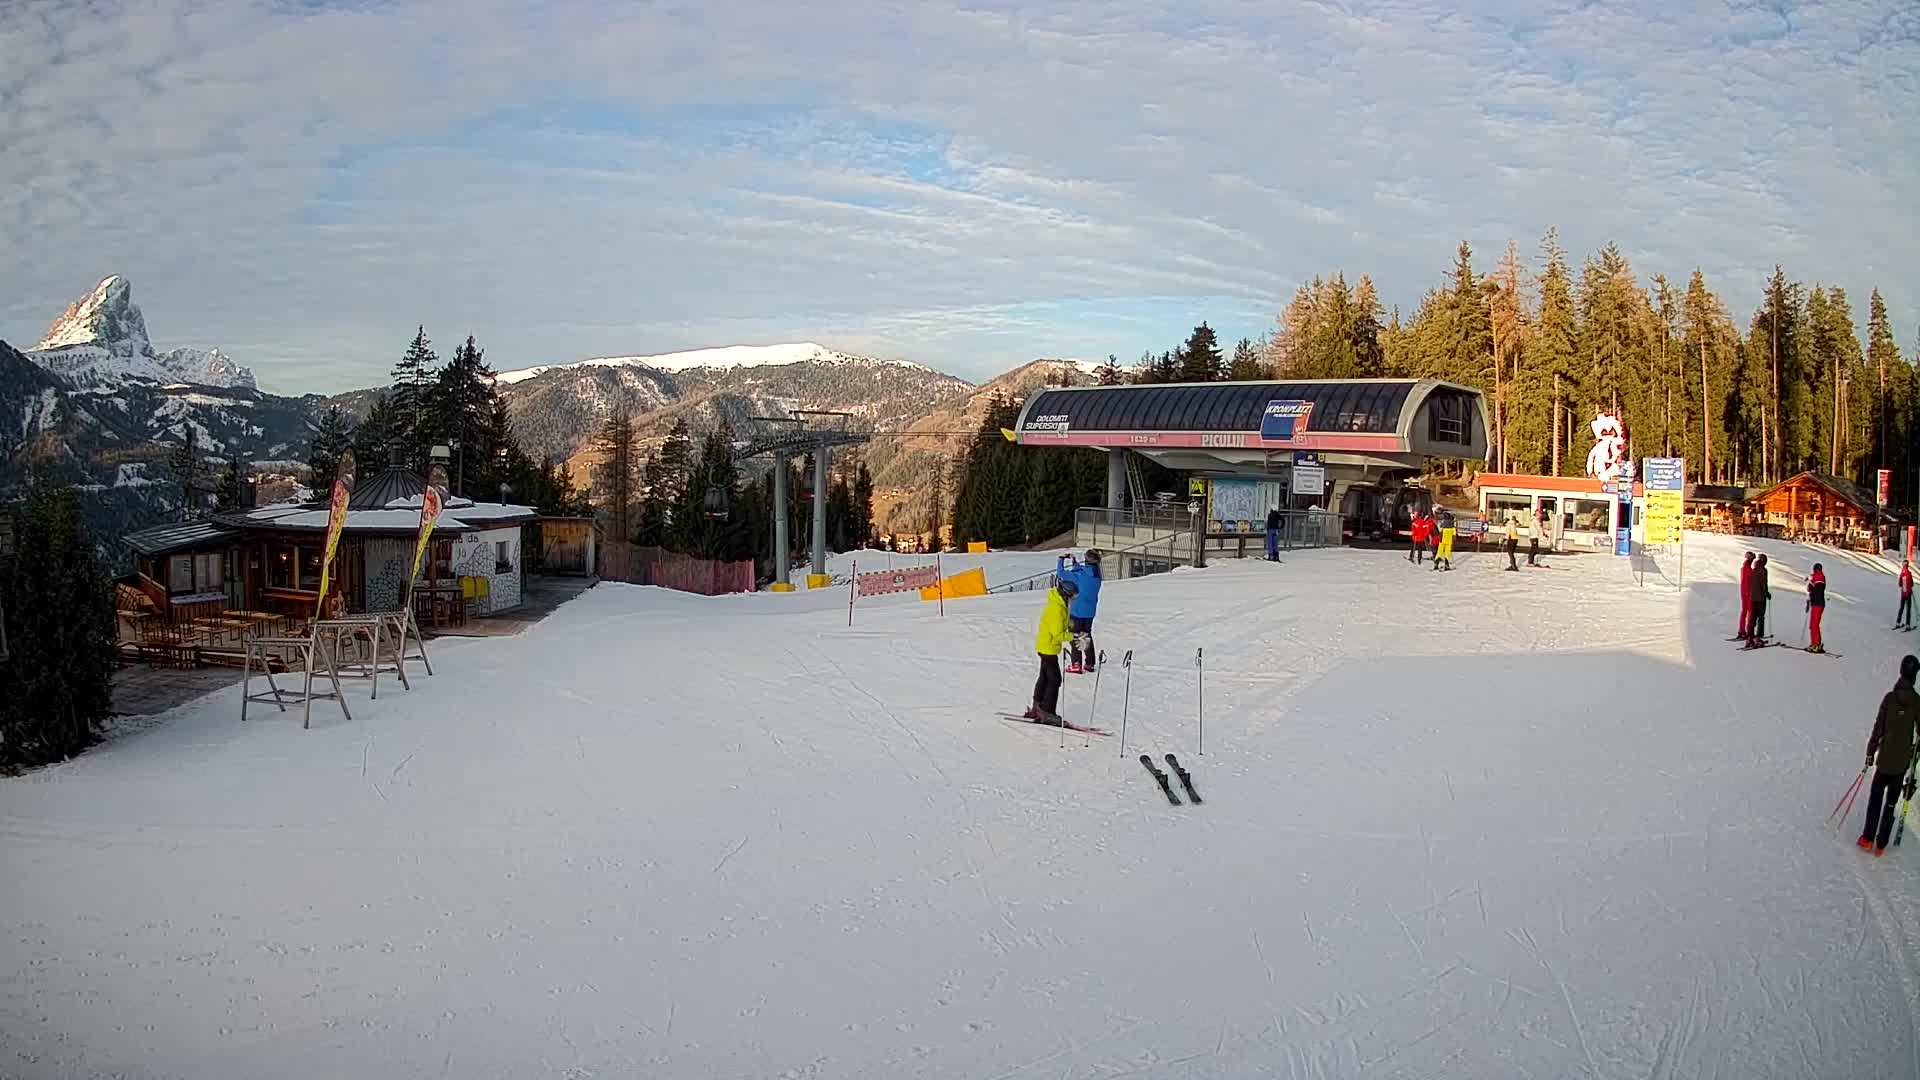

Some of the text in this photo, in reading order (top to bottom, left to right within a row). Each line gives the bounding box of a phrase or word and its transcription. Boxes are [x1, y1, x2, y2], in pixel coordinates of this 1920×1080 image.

[1264, 405, 1313, 414] KRONPLATZ
[1025, 422, 1058, 430] SUPERSKI
[1201, 433, 1245, 447] PICULIN
